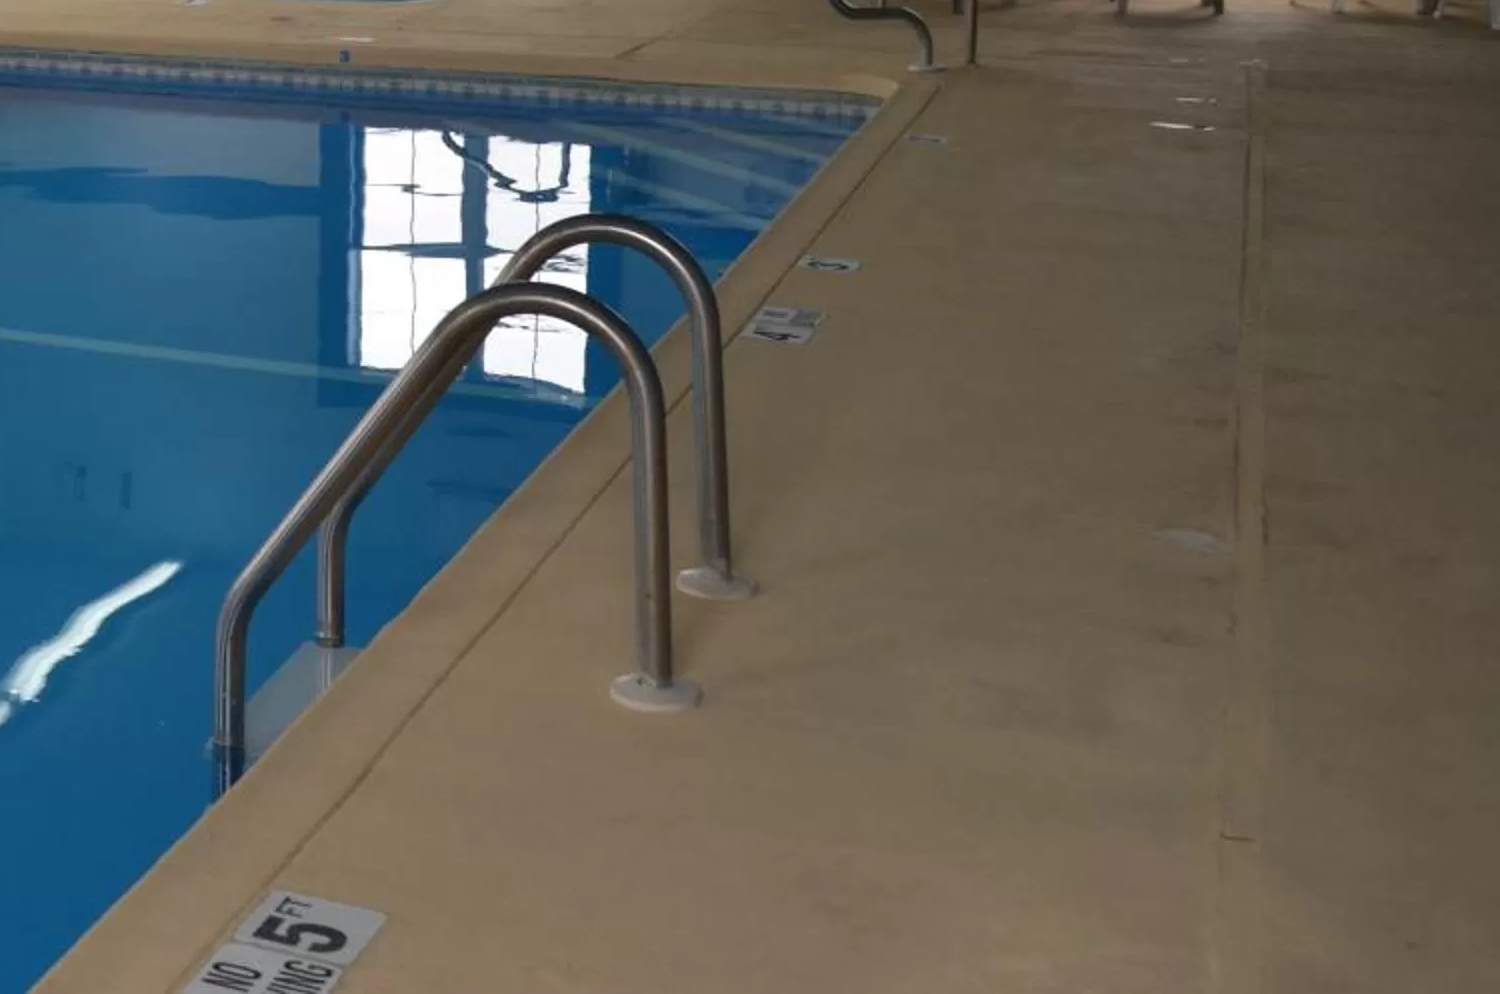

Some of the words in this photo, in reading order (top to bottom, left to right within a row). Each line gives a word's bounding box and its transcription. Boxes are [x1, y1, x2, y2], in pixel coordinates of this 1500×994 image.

[275, 895, 313, 918] FT
[252, 914, 348, 953] 5
[201, 961, 262, 993] NO
[265, 960, 333, 994] ING
